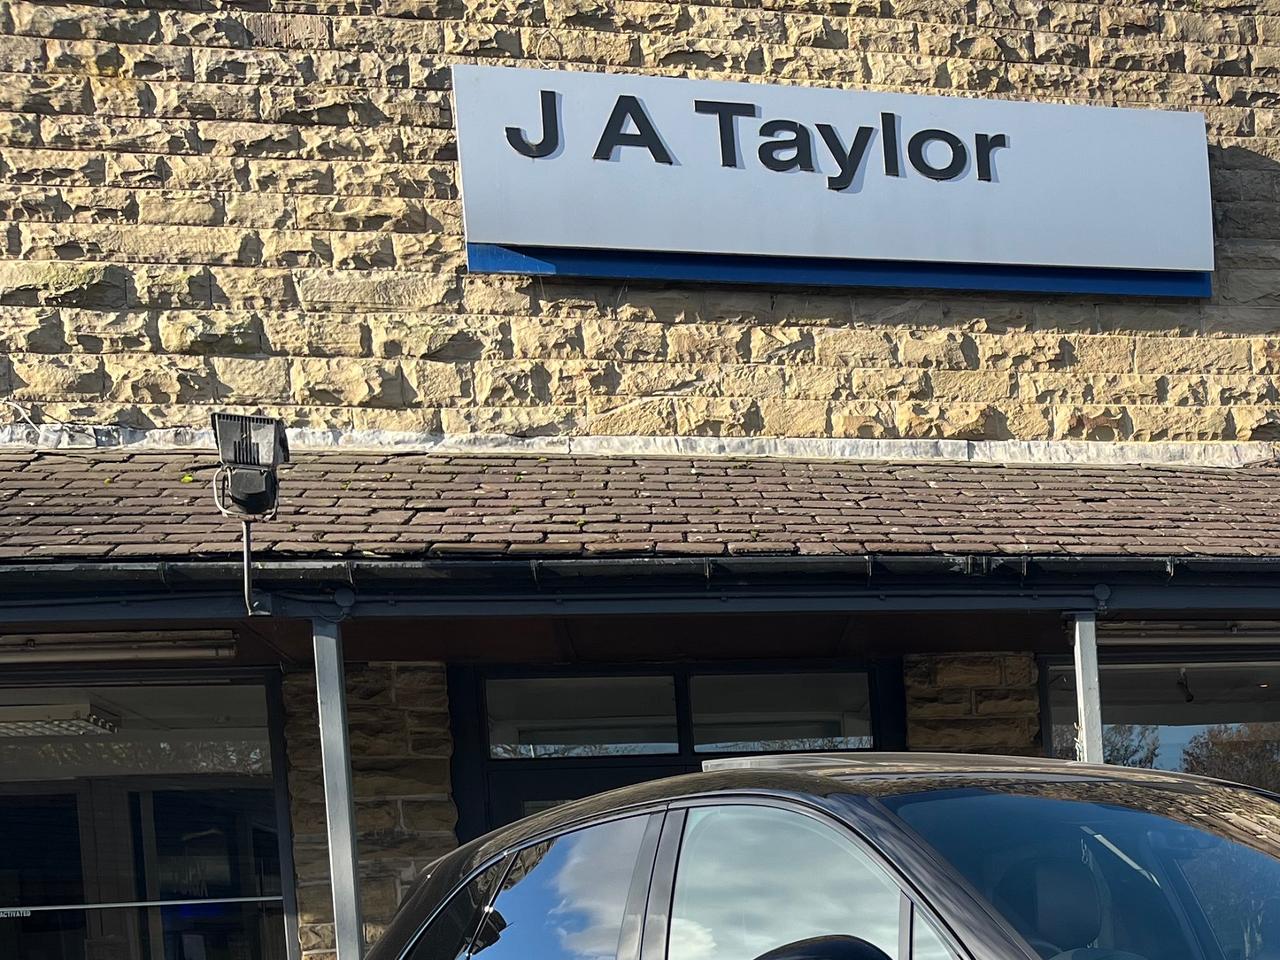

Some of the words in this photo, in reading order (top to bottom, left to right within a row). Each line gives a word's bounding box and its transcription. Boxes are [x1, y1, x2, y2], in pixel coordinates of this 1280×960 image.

[505, 90, 560, 159] J
[592, 94, 674, 166] A
[694, 99, 1008, 192] Taylor
